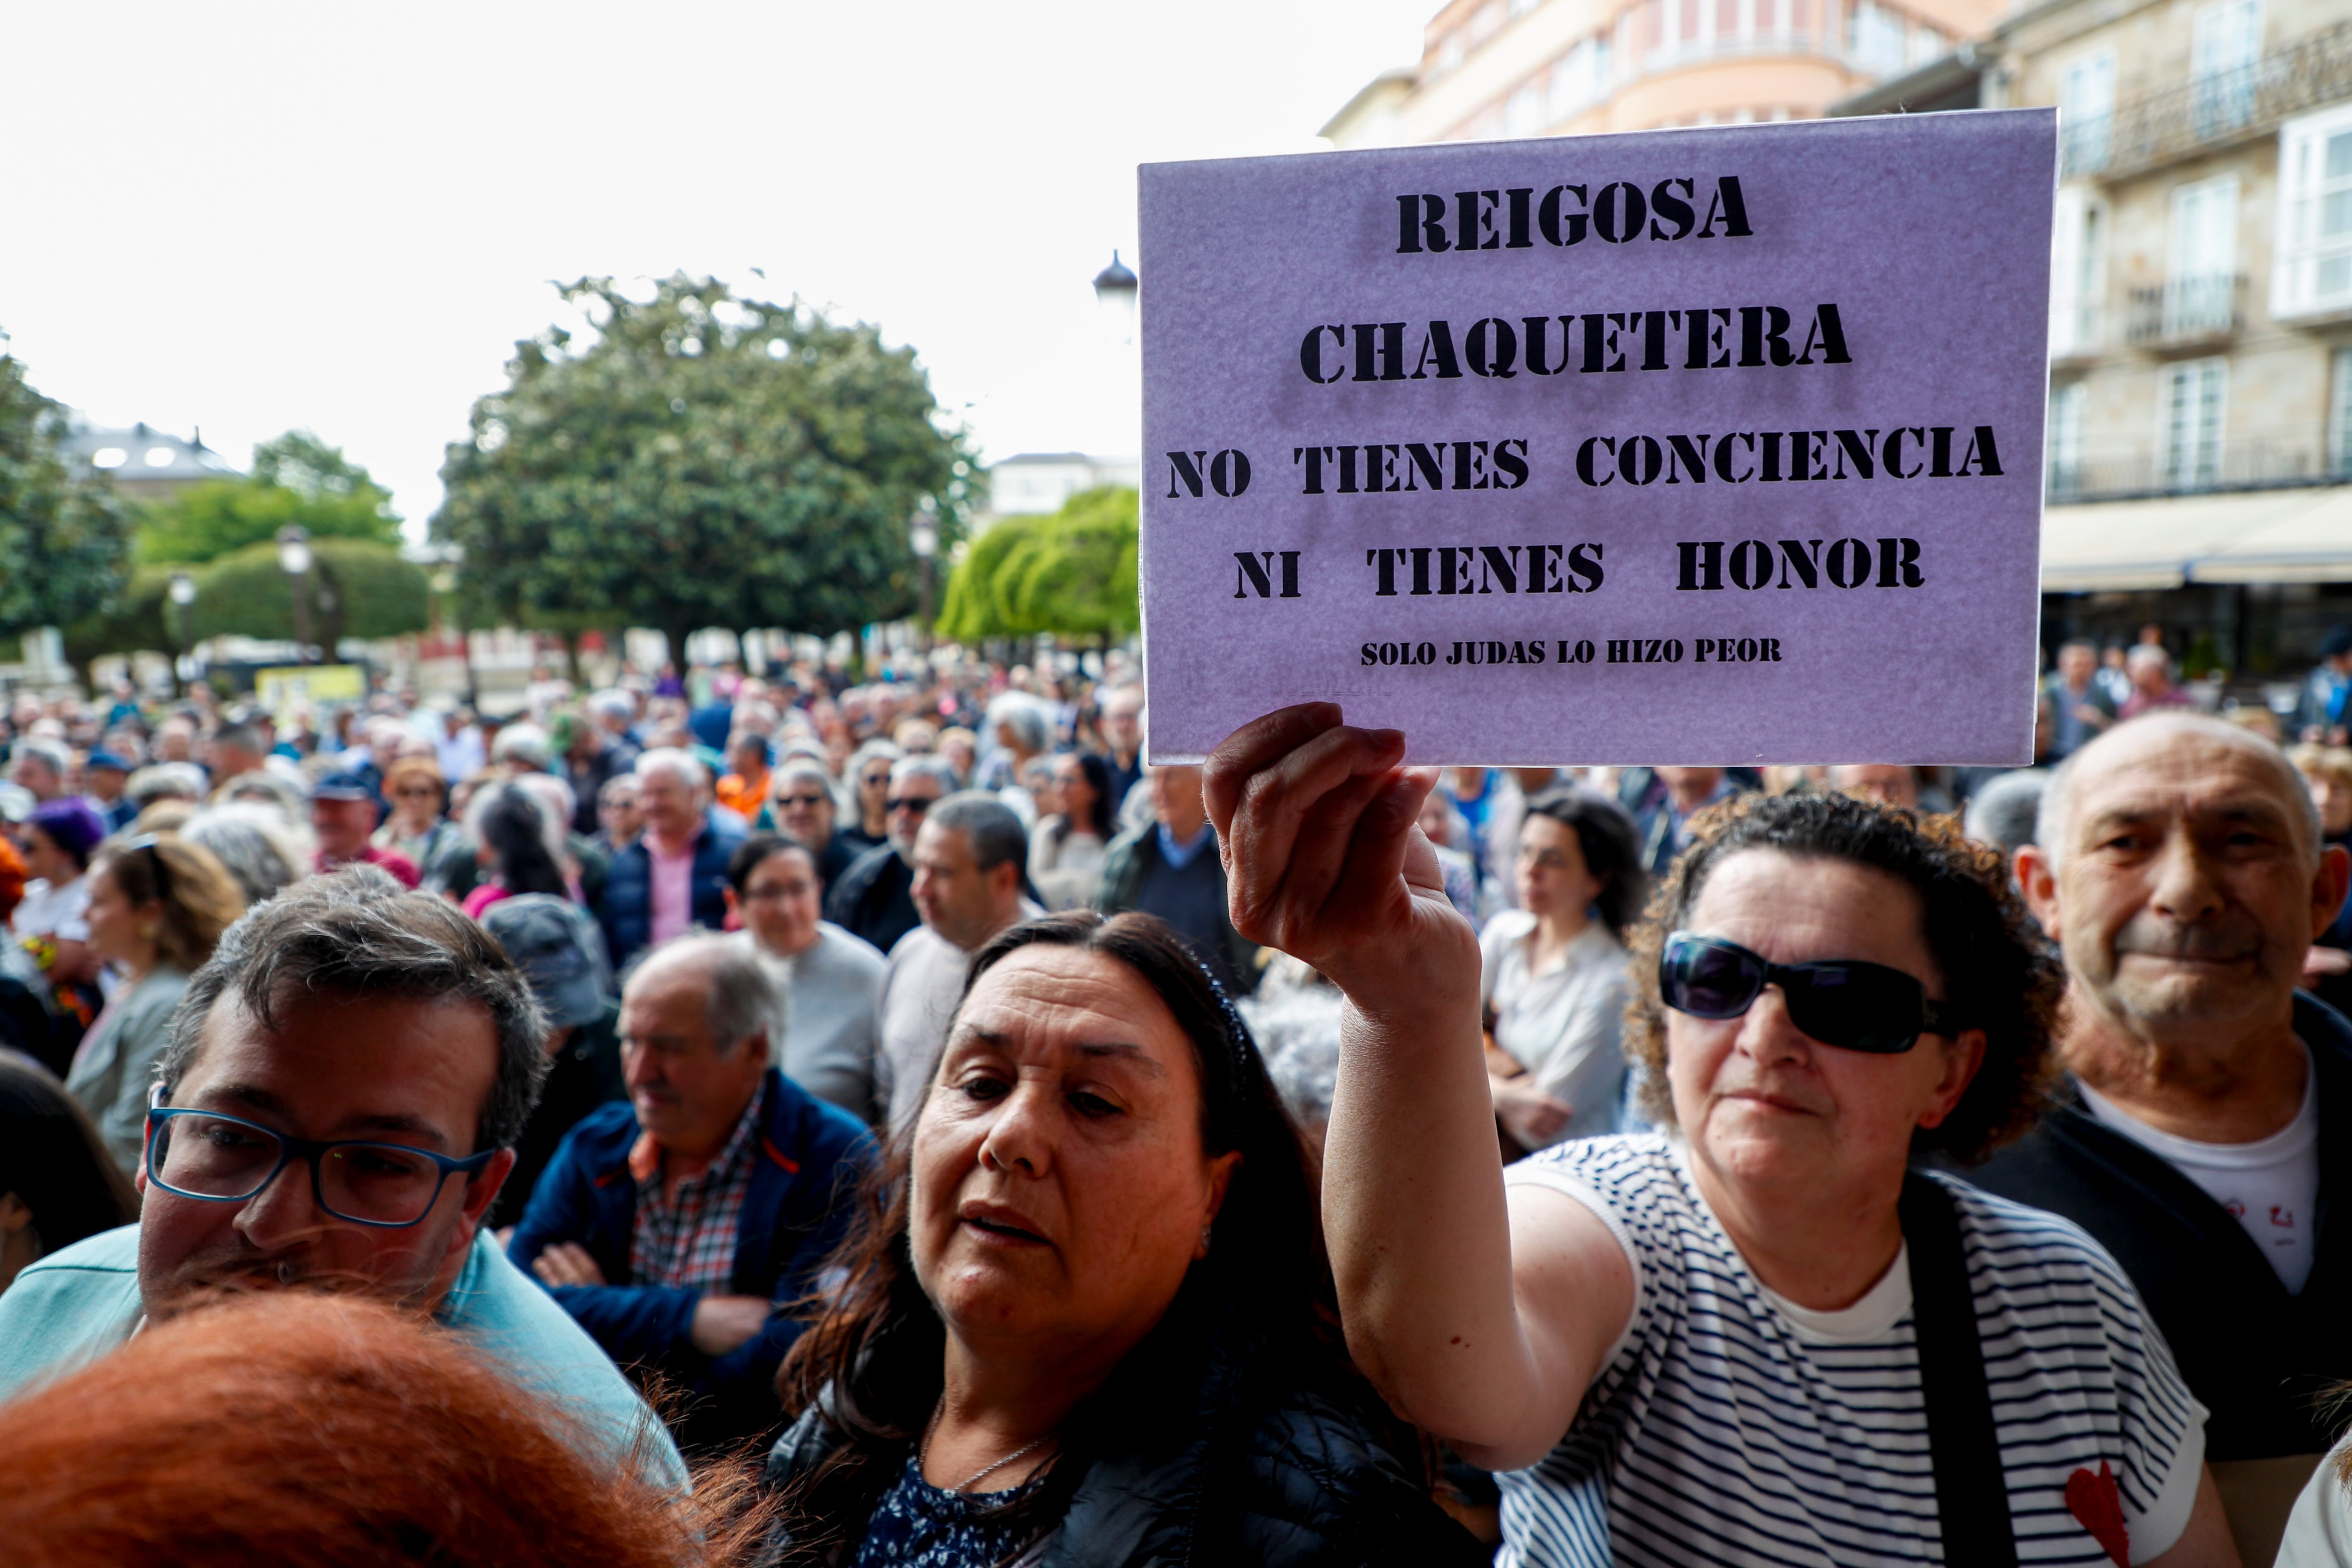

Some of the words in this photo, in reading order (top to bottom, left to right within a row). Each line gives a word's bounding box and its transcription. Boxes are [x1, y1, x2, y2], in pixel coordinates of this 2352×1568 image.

[1396, 176, 1753, 254] REIGOSA
[1301, 304, 1852, 384] CHAQUETERA
[1167, 450, 1250, 498] NO
[1294, 439, 1528, 494] TIENES
[1576, 426, 2004, 486] CONCIENCIA
[1234, 551, 1301, 598] NI
[1367, 543, 1604, 596] TIENES
[1676, 538, 1925, 590] HONOR
[1361, 642, 1436, 666] SOLO
[1446, 641, 1545, 665] JUDAS
[1557, 640, 1595, 663] LO
[1607, 639, 1683, 663] HIZO
[1695, 638, 1782, 662] PEOR
